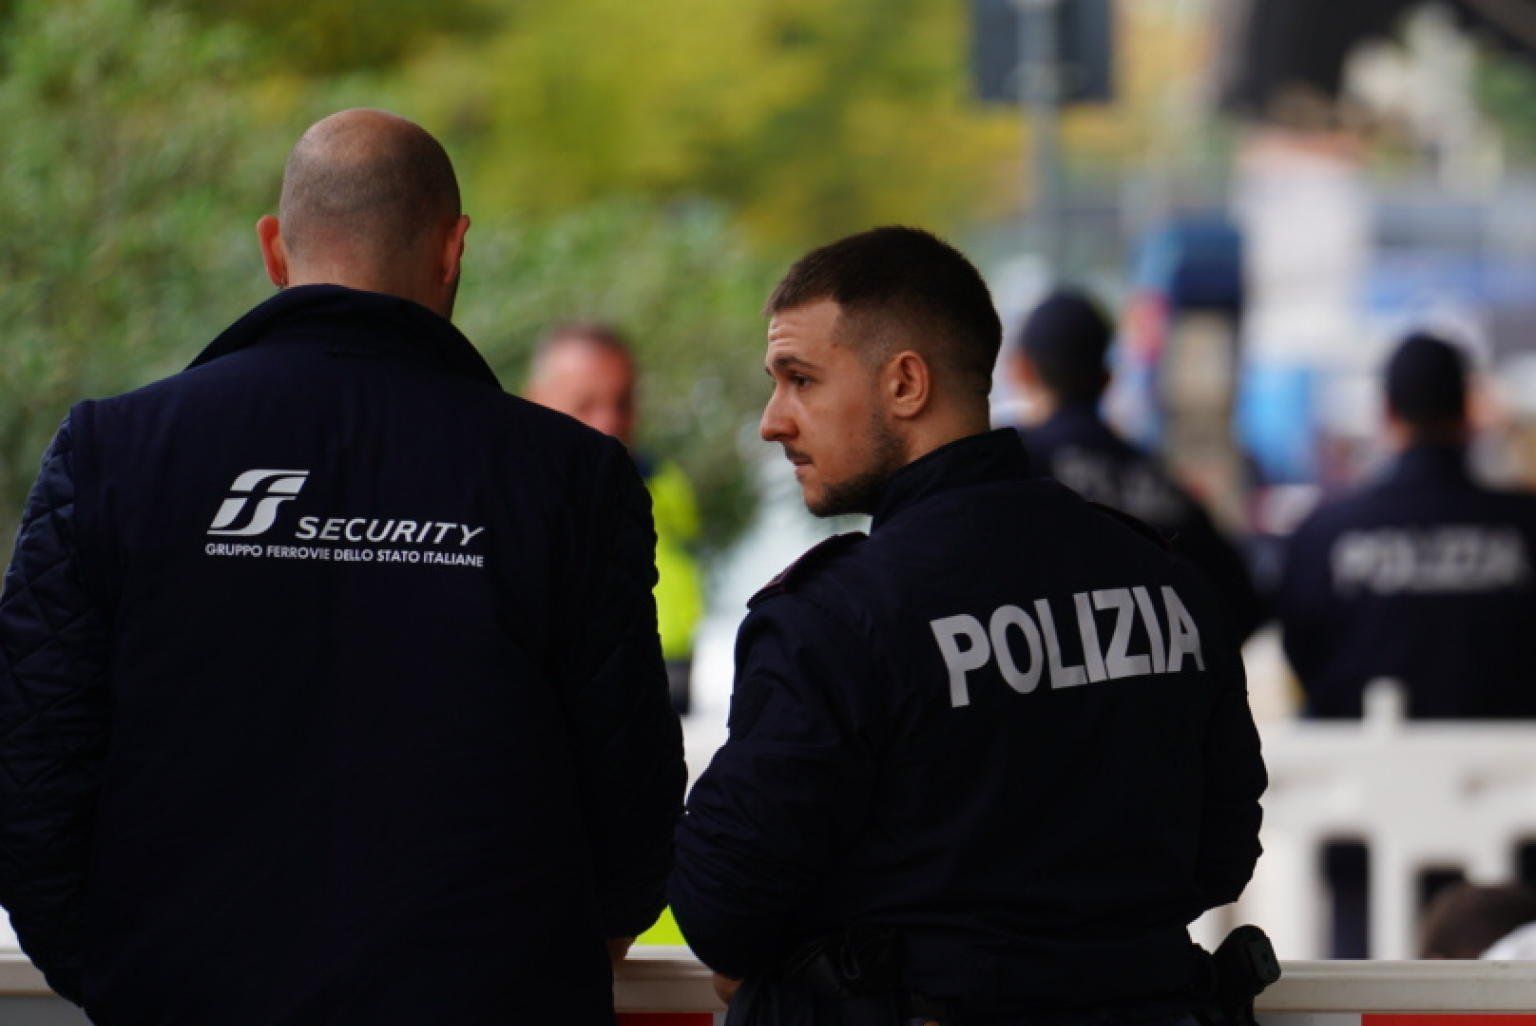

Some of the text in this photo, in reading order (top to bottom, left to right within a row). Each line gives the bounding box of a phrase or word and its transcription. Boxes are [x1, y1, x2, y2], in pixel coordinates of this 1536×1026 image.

[295, 516, 484, 546] SECURITY
[204, 542, 484, 568] GRUPPO FERROVIE DELLO STATO ITALIANE
[929, 585, 1205, 708] POLIZIA
